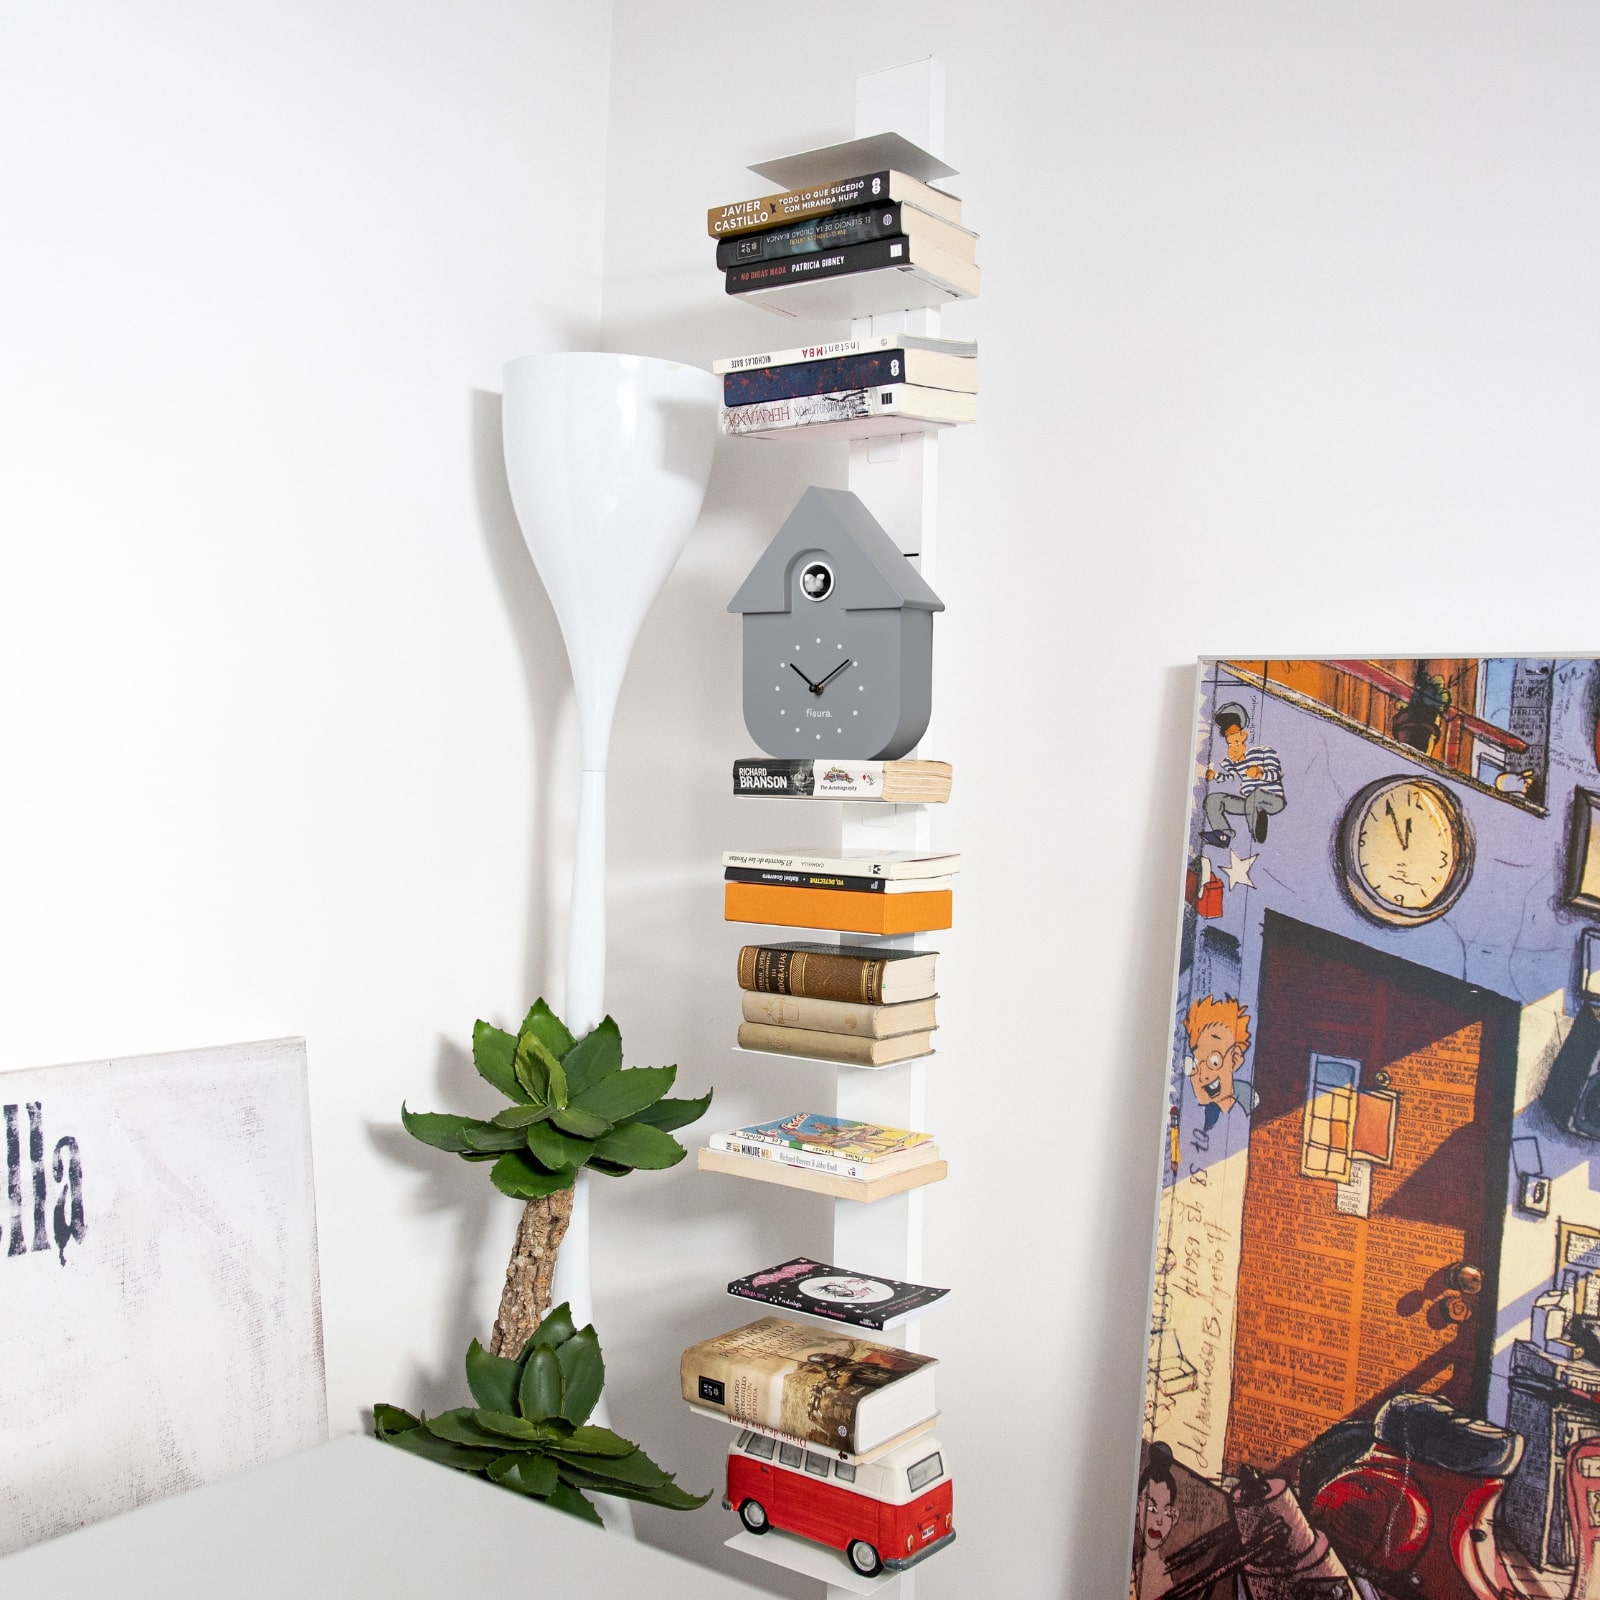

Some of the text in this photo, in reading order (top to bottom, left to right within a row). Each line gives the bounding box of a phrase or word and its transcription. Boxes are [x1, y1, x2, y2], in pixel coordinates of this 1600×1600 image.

[779, 195, 799, 206] TODO
[801, 193, 812, 202] LO
[813, 190, 829, 200] QUE
[830, 180, 864, 196] SUCEDIÓ
[722, 200, 761, 218] JAVIER
[784, 191, 859, 214] CON MIRANDA HUFF
[714, 211, 769, 232] CASTILLO
[815, 225, 823, 234] LA
[824, 223, 833, 232] DE
[766, 230, 791, 243] BLANCA
[791, 226, 814, 239] CIUDAD
[741, 255, 845, 281] NO DIGAS NADA PATRICIA GIBNEY
[731, 354, 772, 368] NICHOLAS BATE
[806, 708, 833, 718] fisura.
[738, 767, 767, 777] RICHARD
[739, 775, 788, 789] BRANSON
[1407, 790, 1424, 811] 12
[765, 857, 785, 866] Secreto
[785, 859, 793, 867] El
[1440, 850, 1448, 869] 3
[741, 1143, 761, 1158] MINUTE
[0, 1101, 89, 1267] lla
[712, 1323, 772, 1350] SANTIAGO
[718, 1325, 795, 1358] POSTEGUILLO
[727, 1414, 808, 1448] Diario de Ana Frank
